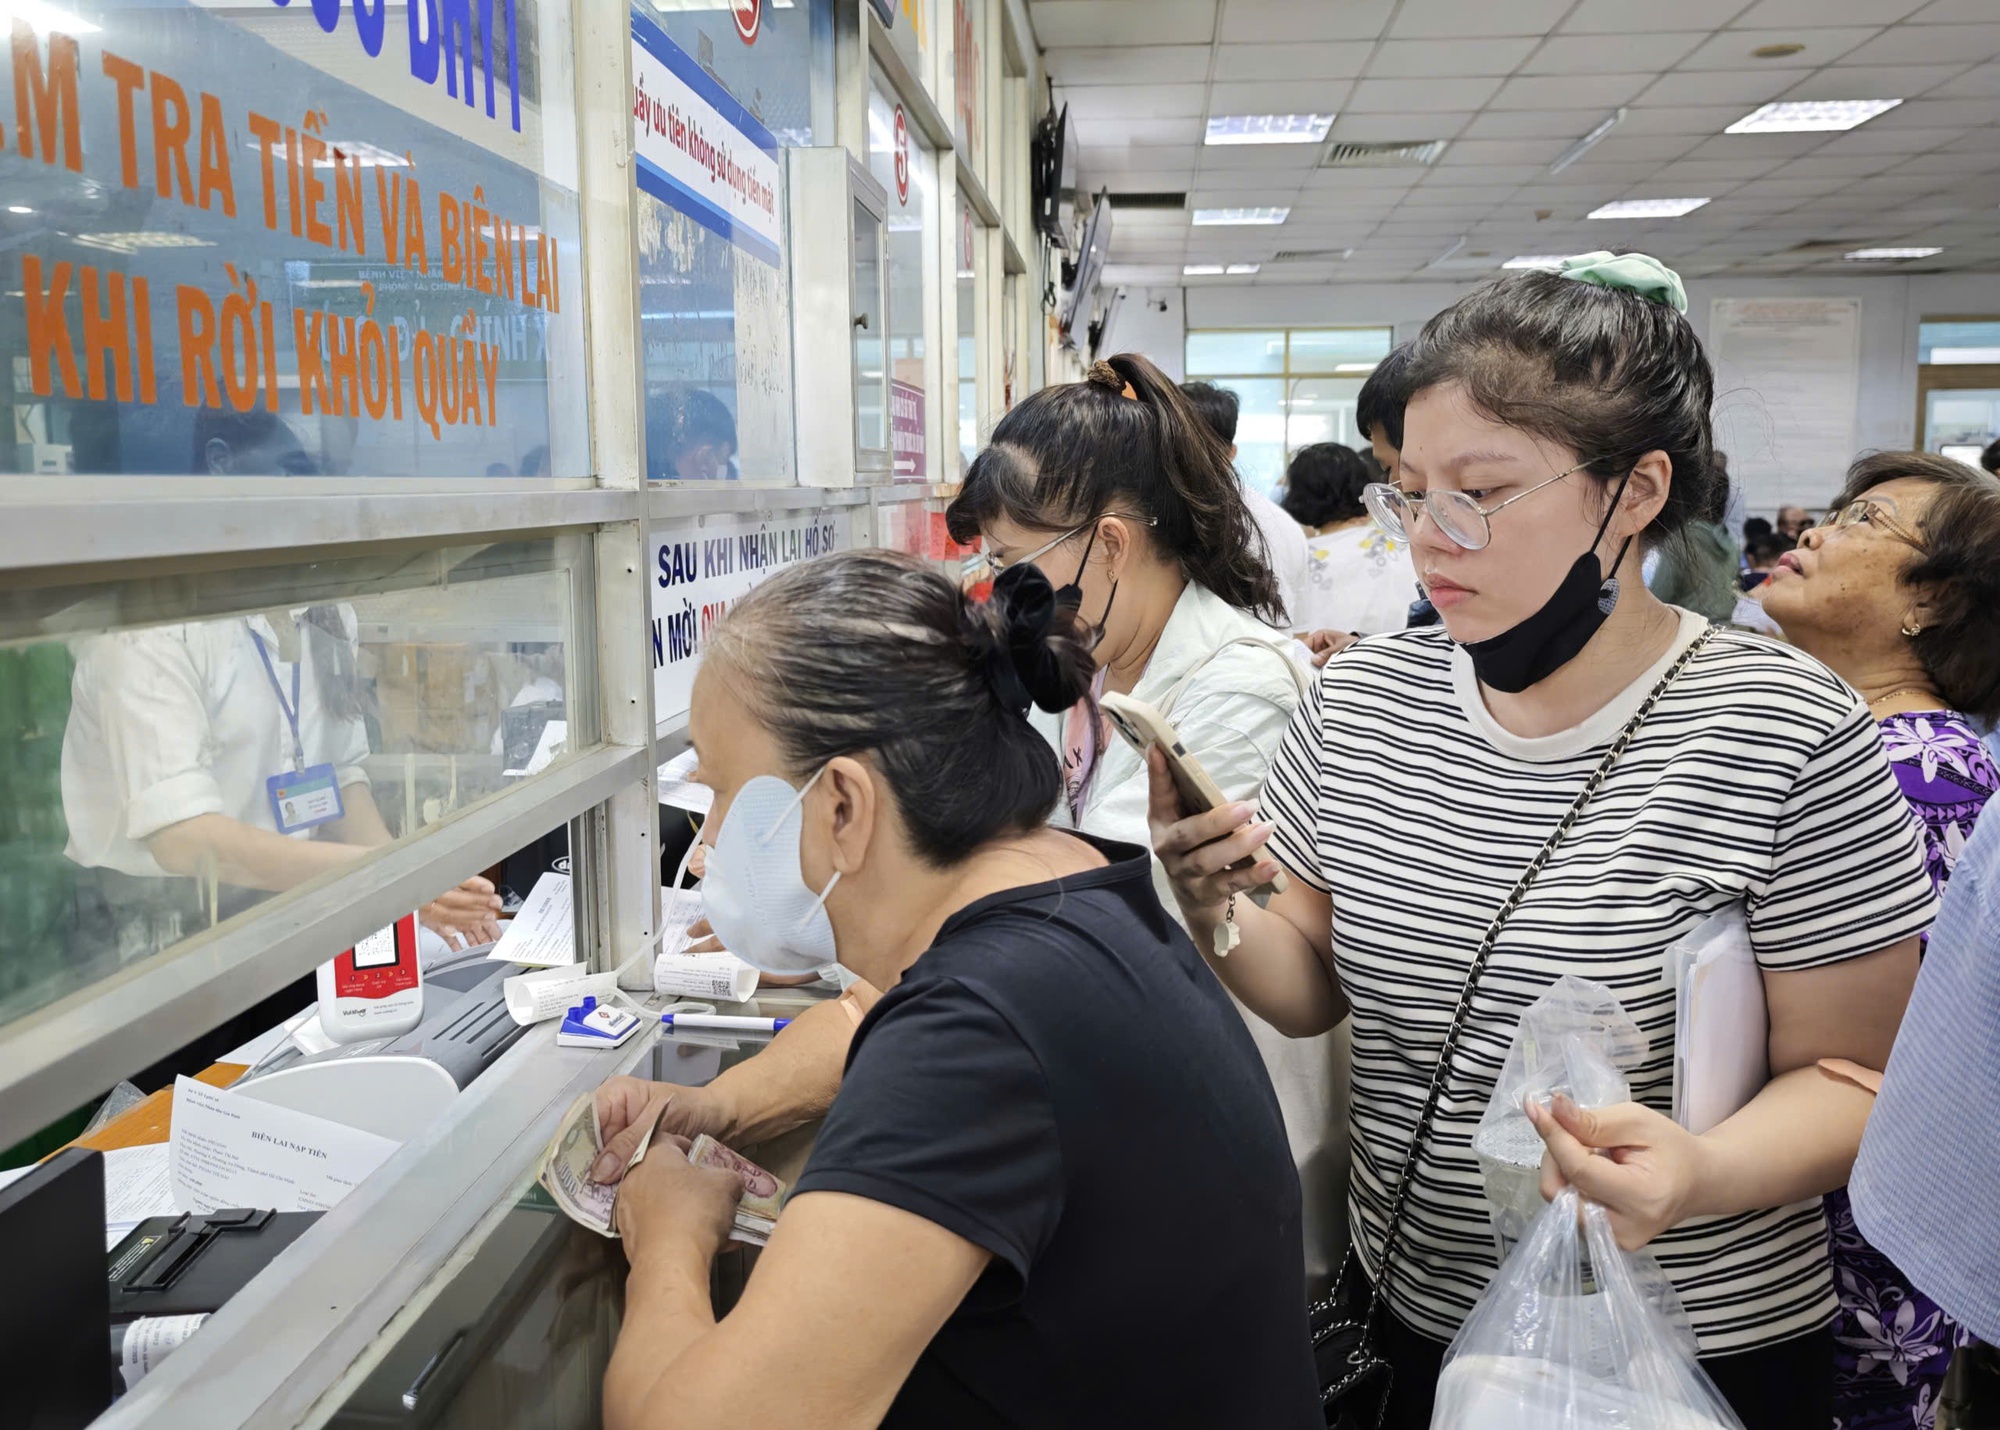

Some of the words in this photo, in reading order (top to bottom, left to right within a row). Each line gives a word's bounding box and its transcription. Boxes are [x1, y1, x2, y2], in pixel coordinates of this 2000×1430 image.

[0, 18, 83, 174] M
[102, 50, 237, 218] TRA
[248, 106, 366, 256] TIỀN
[375, 150, 429, 274] VÀ
[440, 185, 514, 300] BIÊN
[519, 225, 560, 314] LAI
[653, 97, 667, 138] ưu
[668, 103, 687, 153] tiên
[688, 115, 716, 184] không
[717, 141, 726, 180] sử
[727, 149, 747, 205] dụng
[22, 254, 157, 405] KHI
[177, 263, 279, 413] RỜI
[294, 281, 403, 421] KHỎI
[414, 308, 499, 441] QUẦY
[658, 541, 698, 588] SAU
[704, 537, 734, 579] KHI
[738, 523, 778, 575] NHẬN
[782, 528, 801, 566] LẠI
[668, 597, 698, 663] MỜI
[251, 1131, 271, 1143] BIÊN
[273, 1138, 288, 1148] LAI
[289, 1143, 306, 1154] NẠP
